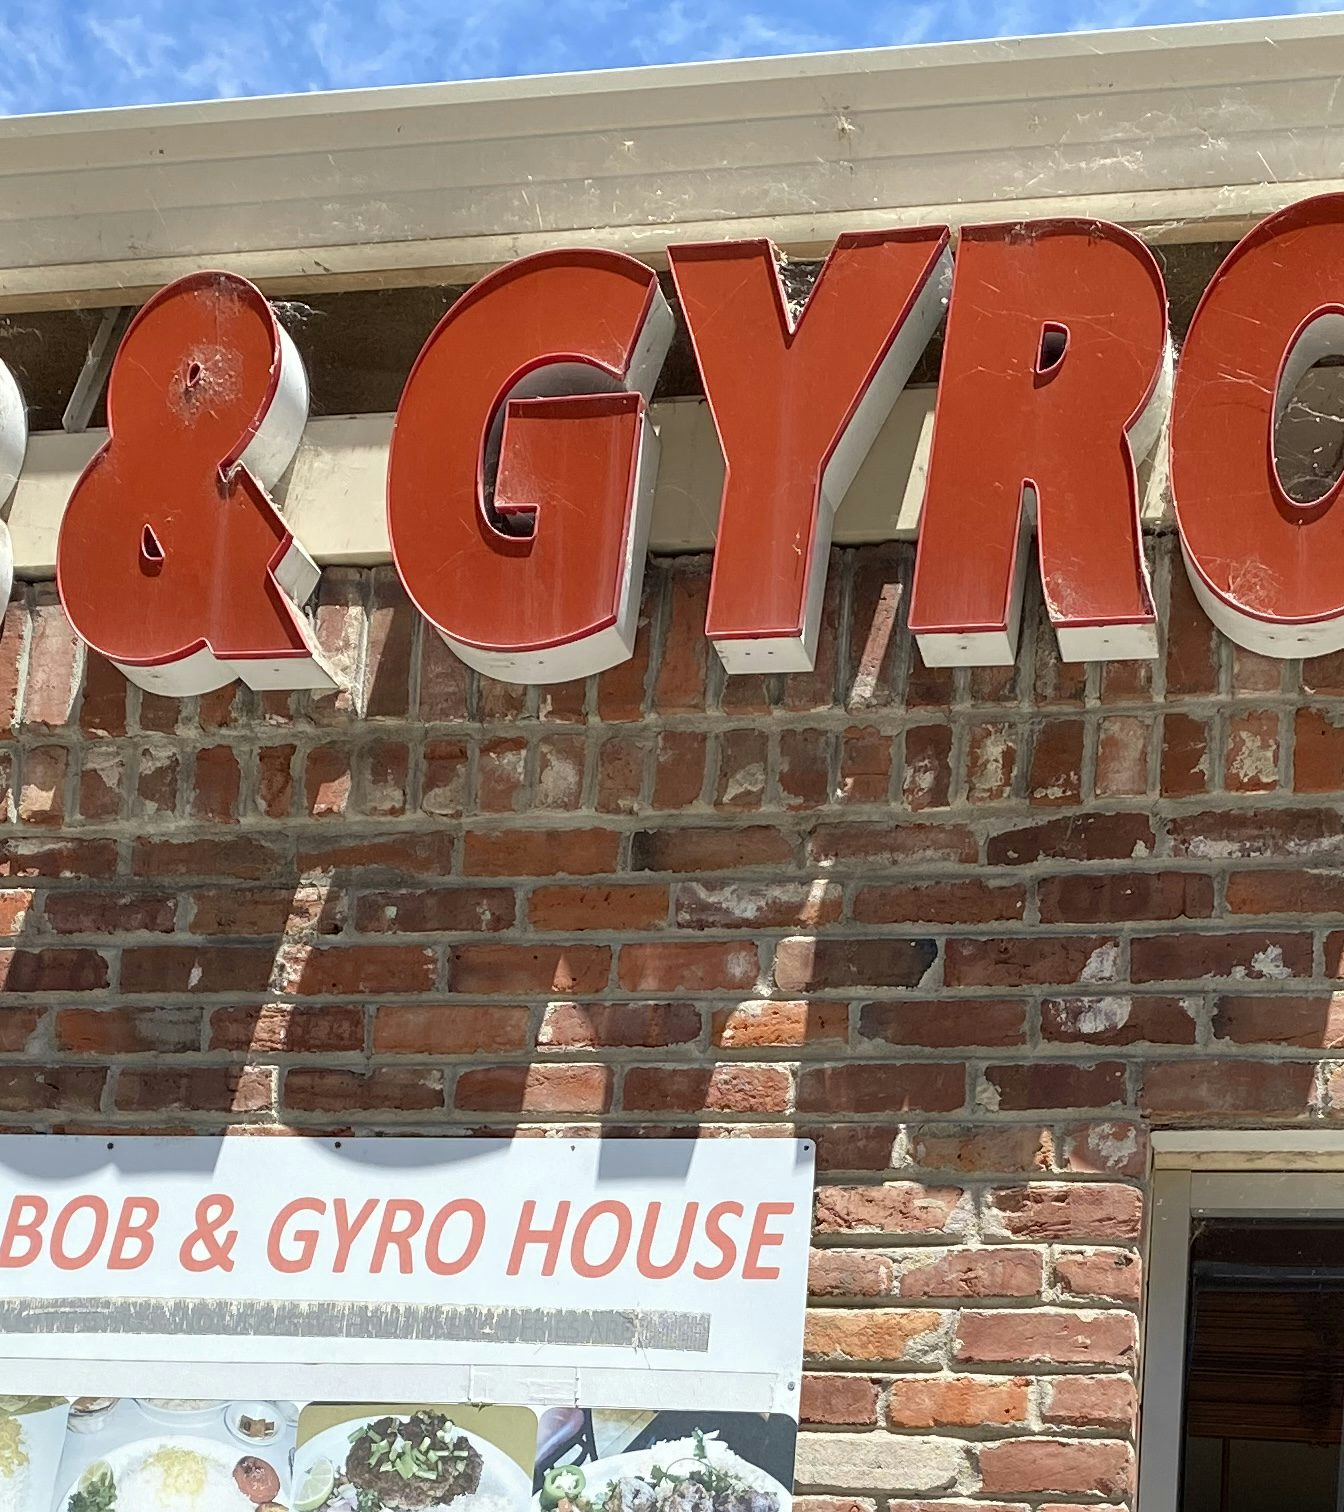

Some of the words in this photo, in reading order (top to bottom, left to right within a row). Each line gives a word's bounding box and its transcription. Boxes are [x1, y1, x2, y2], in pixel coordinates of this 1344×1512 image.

[56, 270, 321, 675] &
[178, 1193, 239, 1273] &
[266, 1197, 487, 1276] GYRO
[505, 1199, 796, 1280] HOUSE
